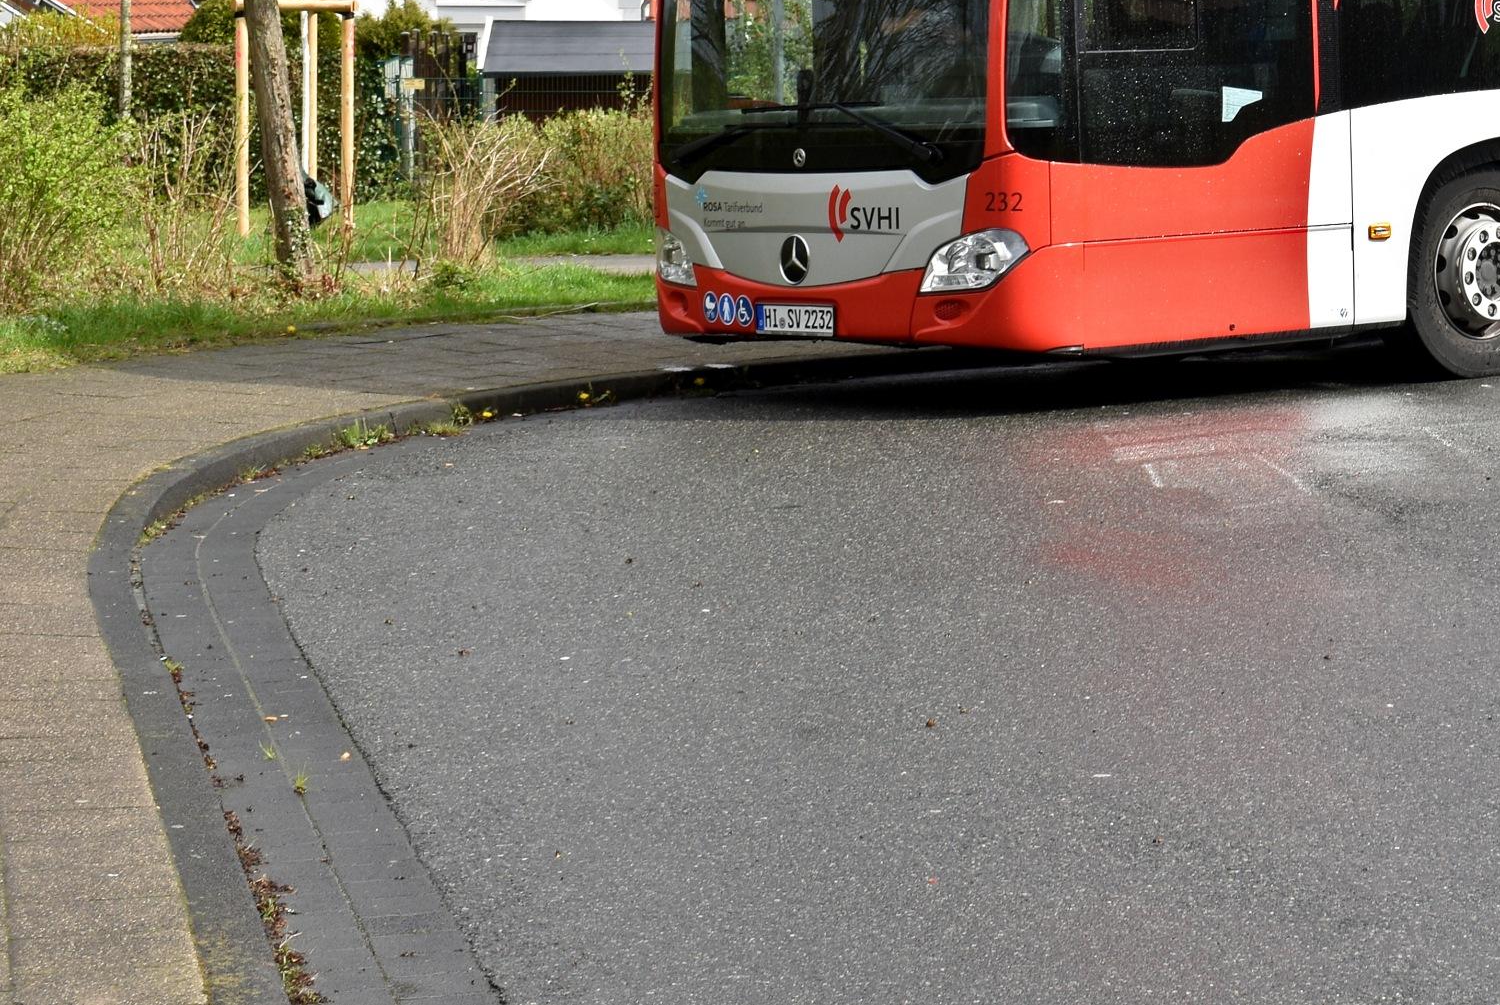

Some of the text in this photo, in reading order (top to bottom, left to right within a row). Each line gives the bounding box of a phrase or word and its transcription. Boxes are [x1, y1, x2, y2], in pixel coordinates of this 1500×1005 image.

[703, 201, 763, 213] ROSA Tarifverbund
[984, 191, 1023, 212] 232
[703, 218, 724, 228] Kommt
[725, 220, 736, 231] gut
[850, 206, 900, 230] SVHI
[764, 308, 832, 329] HI SV 2232
